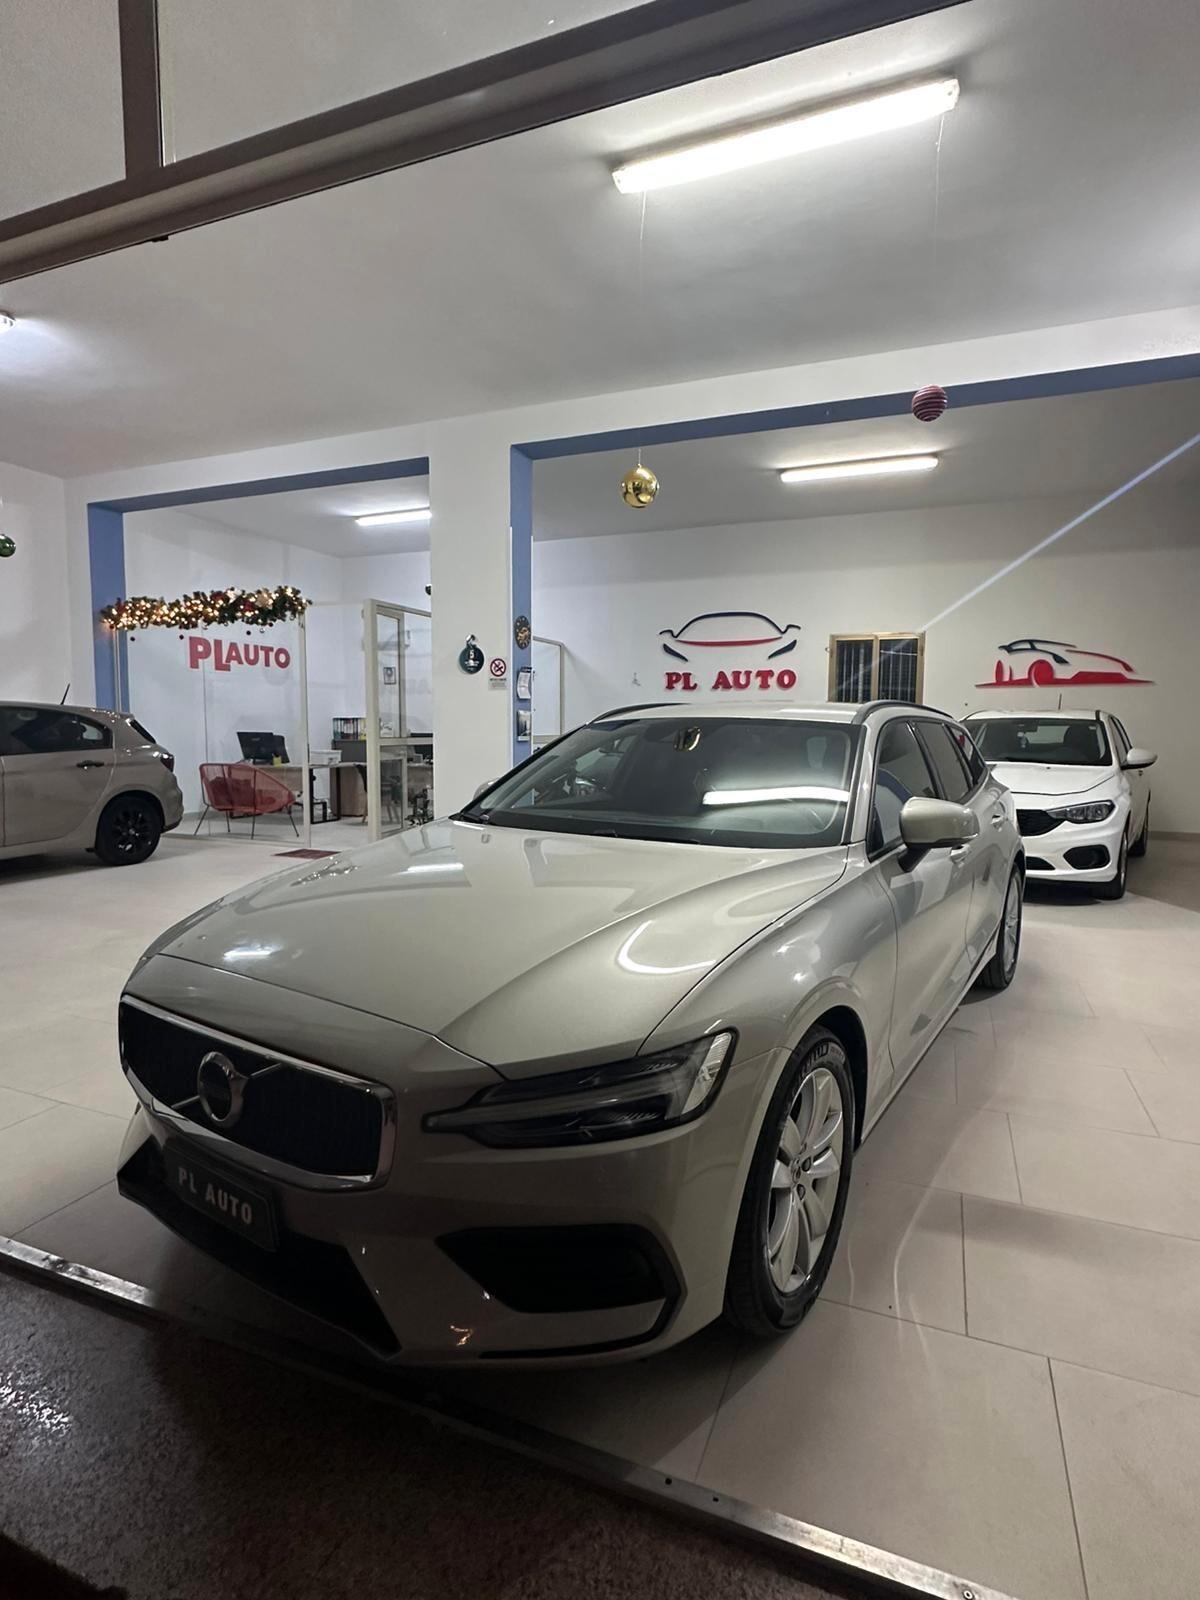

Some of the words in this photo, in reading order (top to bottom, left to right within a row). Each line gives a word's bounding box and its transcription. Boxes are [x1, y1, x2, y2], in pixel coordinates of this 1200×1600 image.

[665, 672, 698, 690] PL
[712, 669, 797, 691] AUTO
[177, 1167, 197, 1193] PL
[205, 1183, 253, 1225] AUTO
